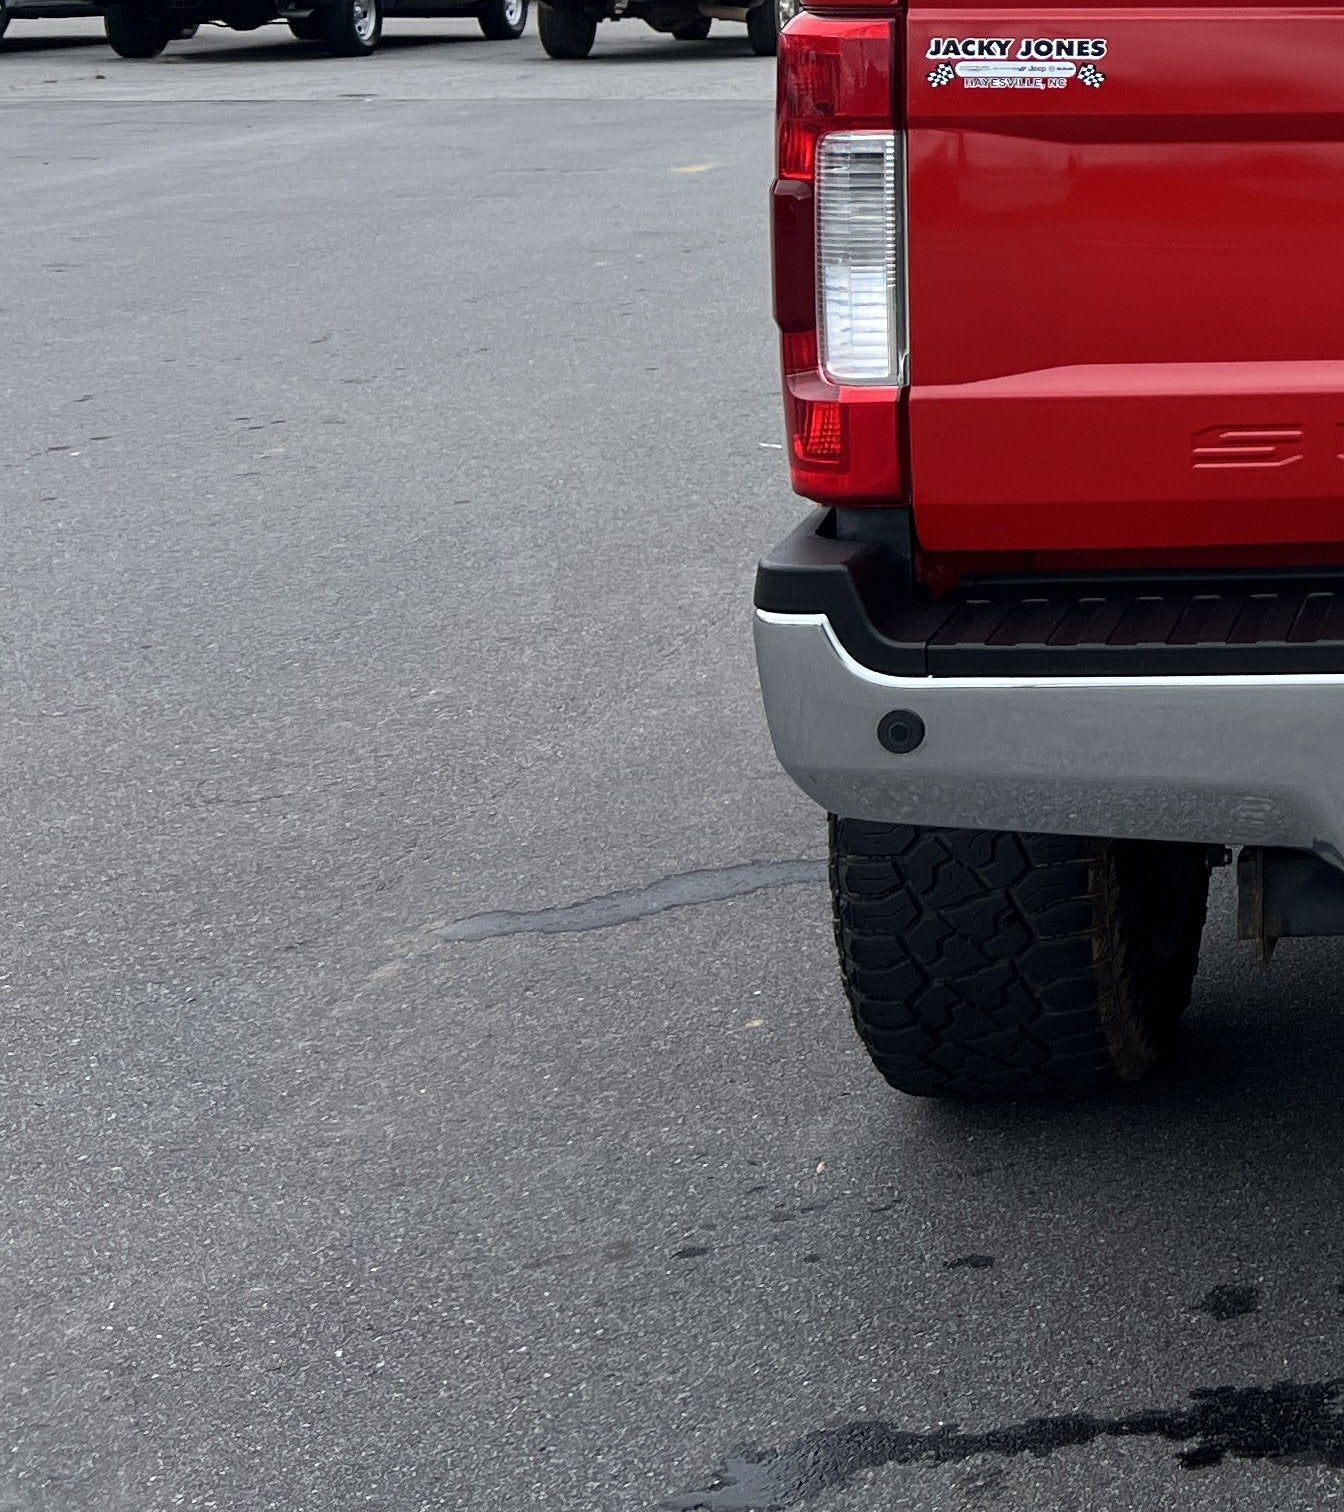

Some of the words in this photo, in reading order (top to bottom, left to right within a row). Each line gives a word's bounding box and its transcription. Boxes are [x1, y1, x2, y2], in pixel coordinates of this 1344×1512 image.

[928, 38, 1013, 58] JACKY
[1018, 38, 1106, 58] JONES
[1048, 78, 1067, 88] NC
